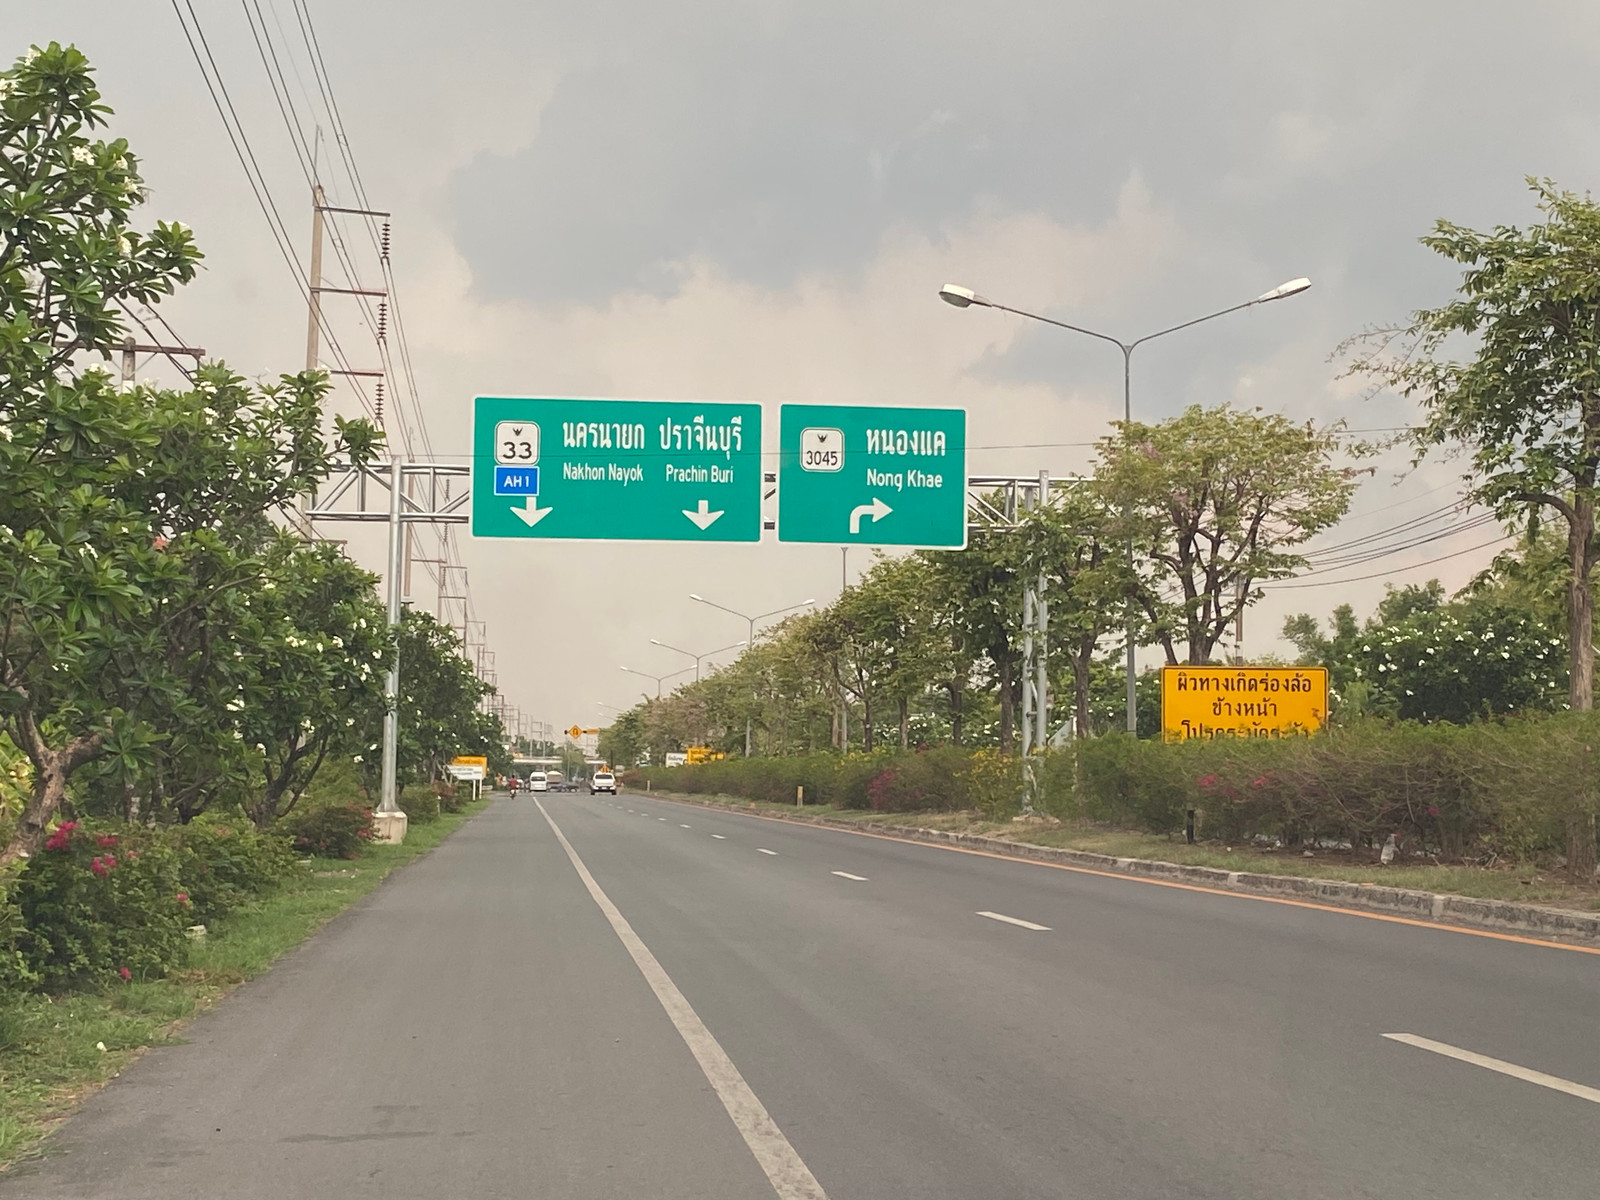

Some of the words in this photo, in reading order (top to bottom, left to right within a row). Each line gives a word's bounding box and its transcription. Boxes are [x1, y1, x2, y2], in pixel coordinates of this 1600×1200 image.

[562, 421, 645, 450] นครนายก
[659, 414, 743, 460] ปราจีนบุรี
[866, 428, 946, 457] หนองแค
[502, 441, 532, 460] 33
[805, 450, 838, 466] 3045
[563, 462, 605, 481] Nakhon
[608, 463, 644, 487] Nayok
[665, 464, 708, 483] Prachin
[710, 465, 734, 484] Buri
[866, 468, 903, 492] Nong
[907, 469, 943, 488] Khae
[1177, 671, 1312, 692] ผิวทางเกิดร่องล้อ
[1211, 697, 1278, 717] ข้างหน้า
